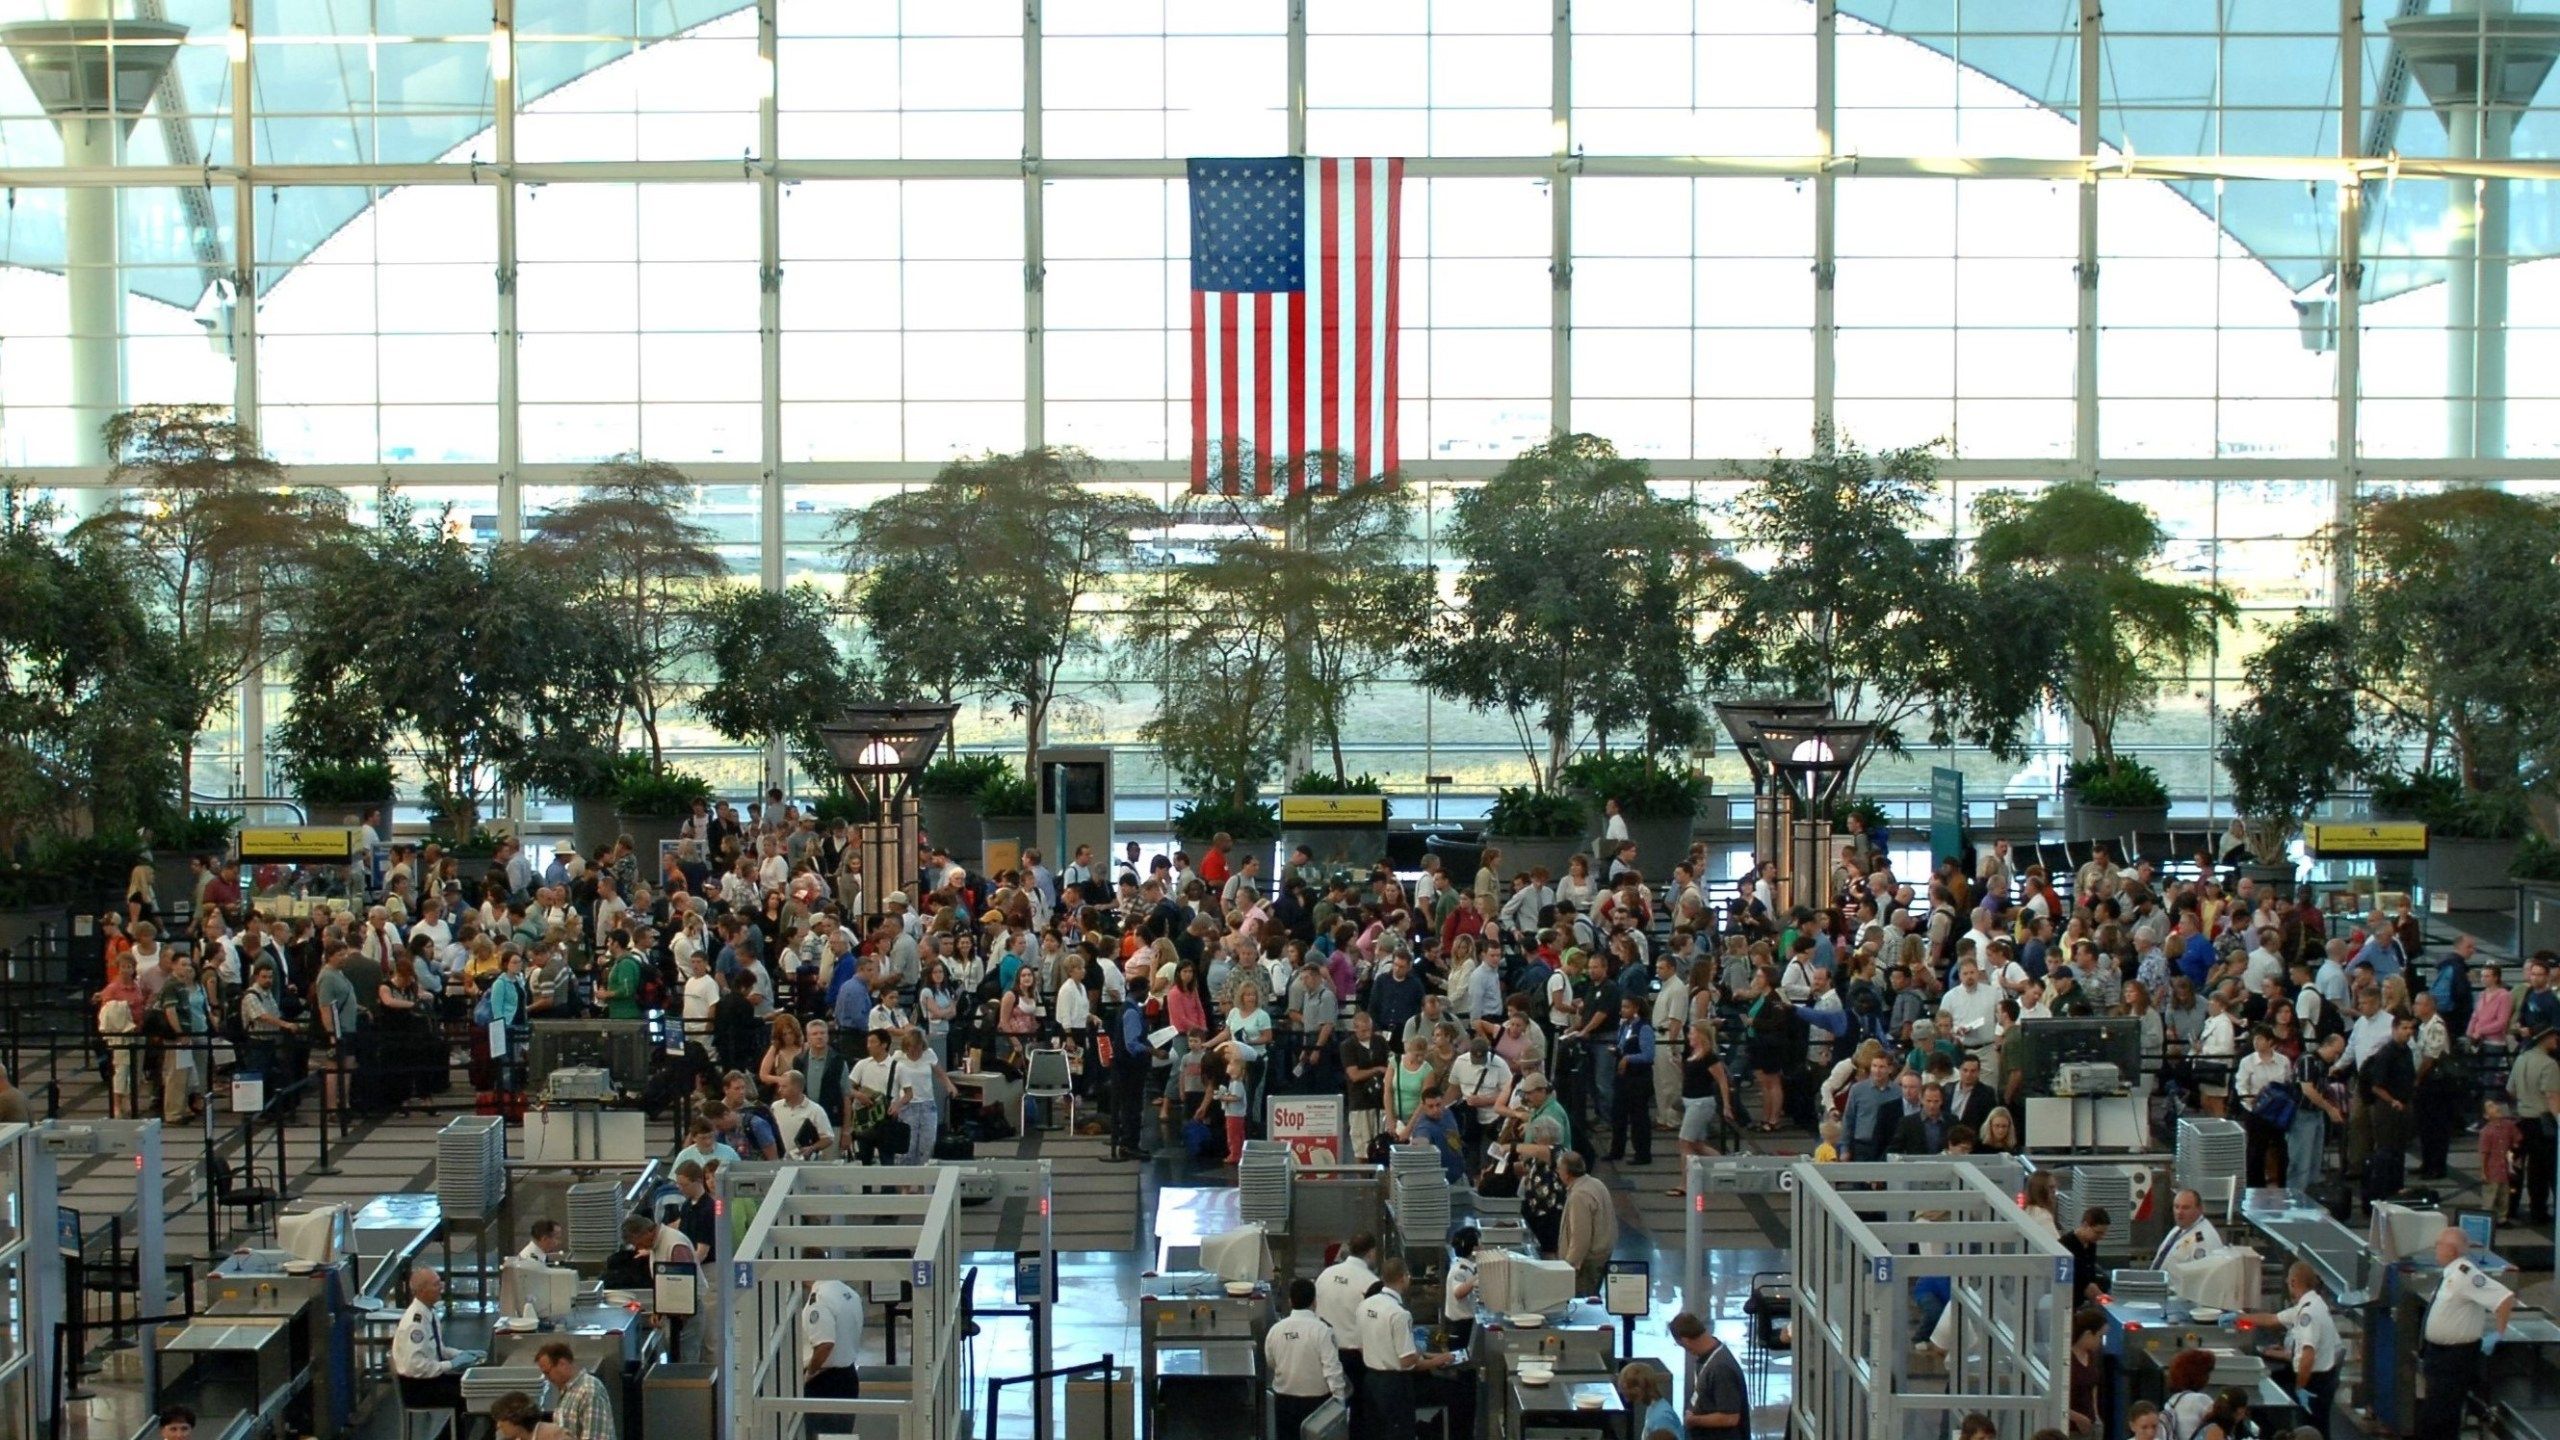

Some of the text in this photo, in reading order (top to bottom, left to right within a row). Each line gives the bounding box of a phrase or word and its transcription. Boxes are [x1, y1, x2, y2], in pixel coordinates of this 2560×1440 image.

[1275, 1108, 1305, 1130] Stop
[739, 1271, 748, 1287] 4
[918, 1270, 926, 1285] 5
[1334, 1275, 1349, 1285] TSA
[1878, 1266, 1887, 1280] 6
[2059, 1266, 2068, 1280] 7
[1284, 1331, 1300, 1341] TSA
